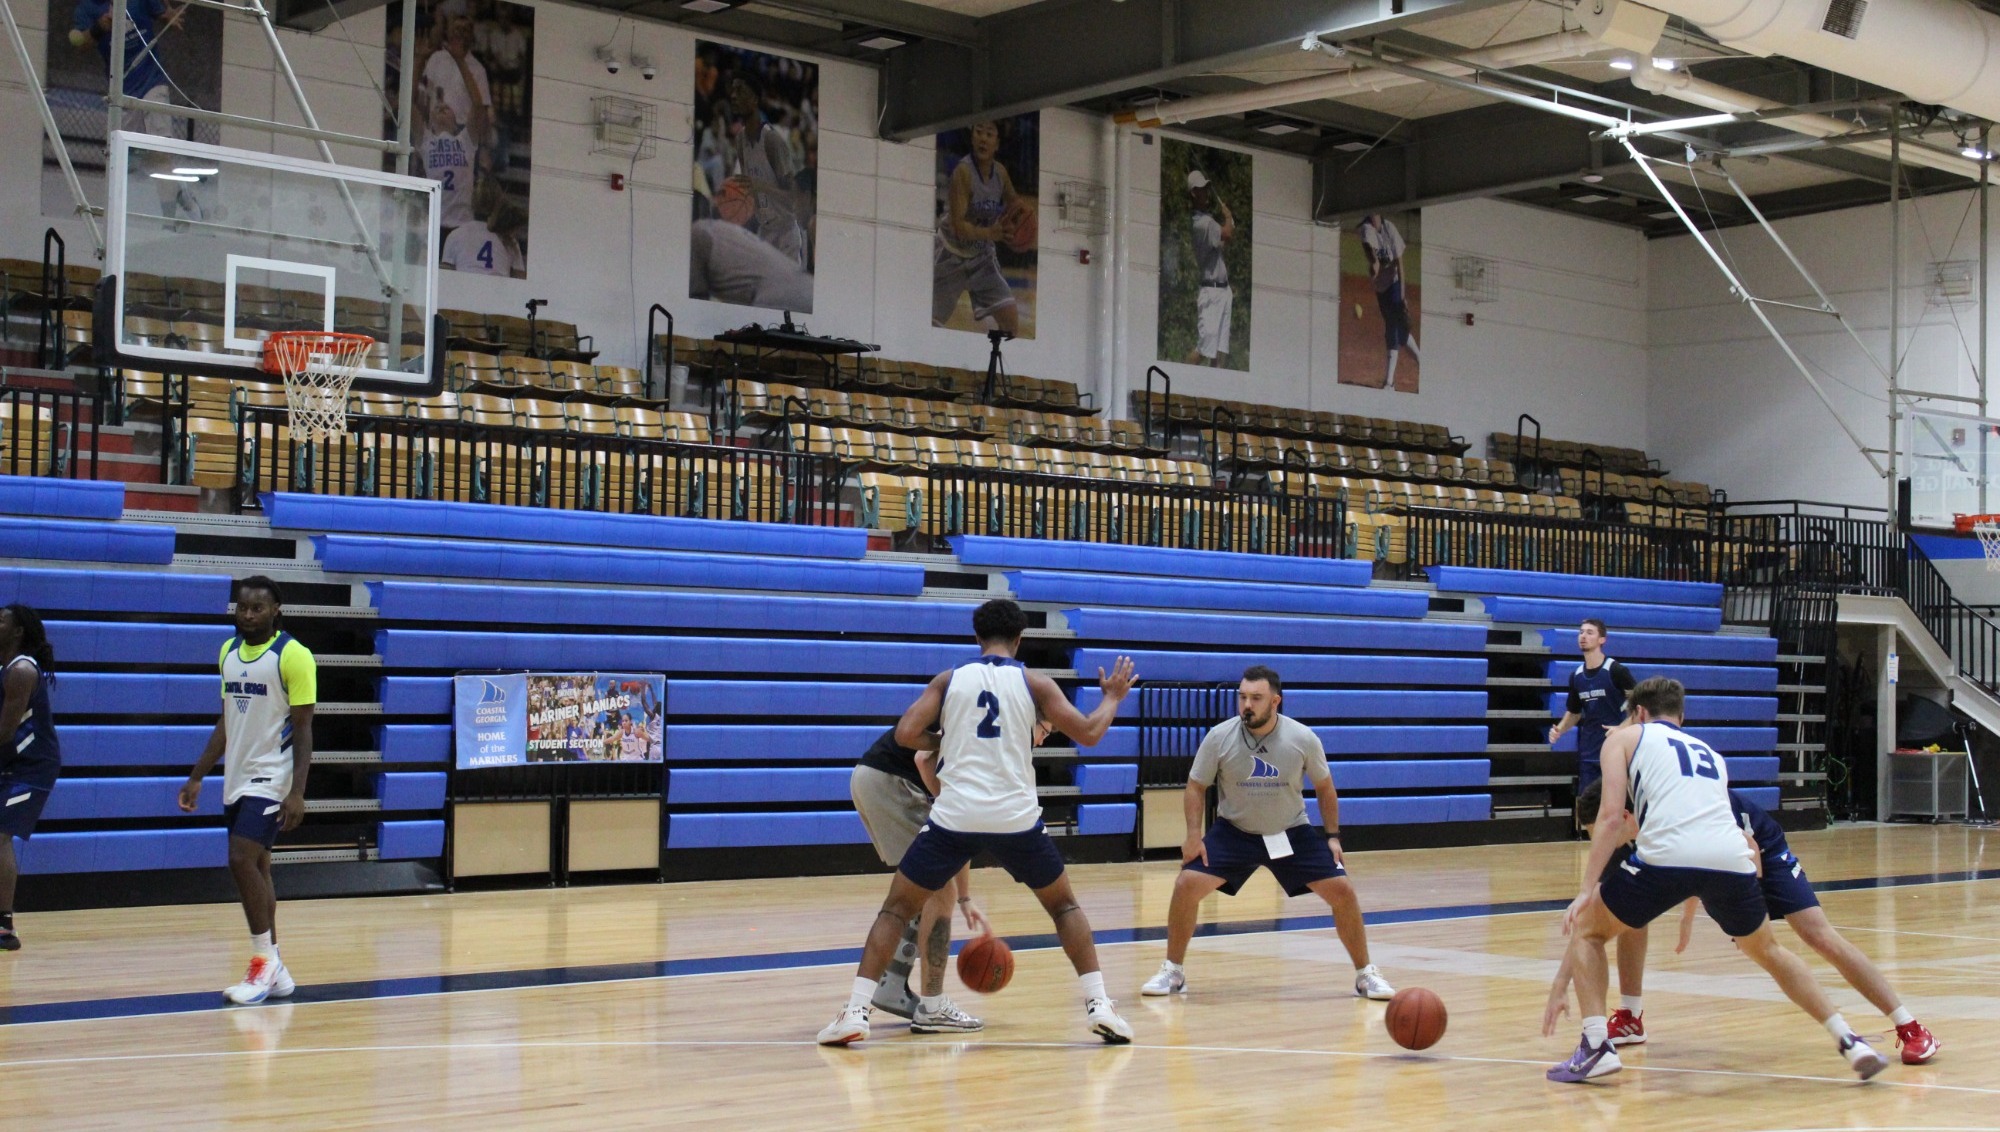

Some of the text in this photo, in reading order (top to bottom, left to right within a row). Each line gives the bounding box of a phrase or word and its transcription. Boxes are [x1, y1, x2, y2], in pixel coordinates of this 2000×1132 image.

[428, 153, 469, 169] GEORGIA
[443, 169, 455, 191] 2
[477, 240, 493, 269] 4
[476, 706, 507, 715] COASTAL
[530, 694, 631, 727] MARINER MANIACS
[977, 690, 1001, 738] 2
[475, 715, 507, 724] GEORGIA
[477, 731, 506, 742] HOME
[529, 737, 604, 750] STUDENT SECTION
[480, 743, 506, 754] of the
[469, 754, 518, 766] MARINERS
[1667, 737, 1720, 780] 13
